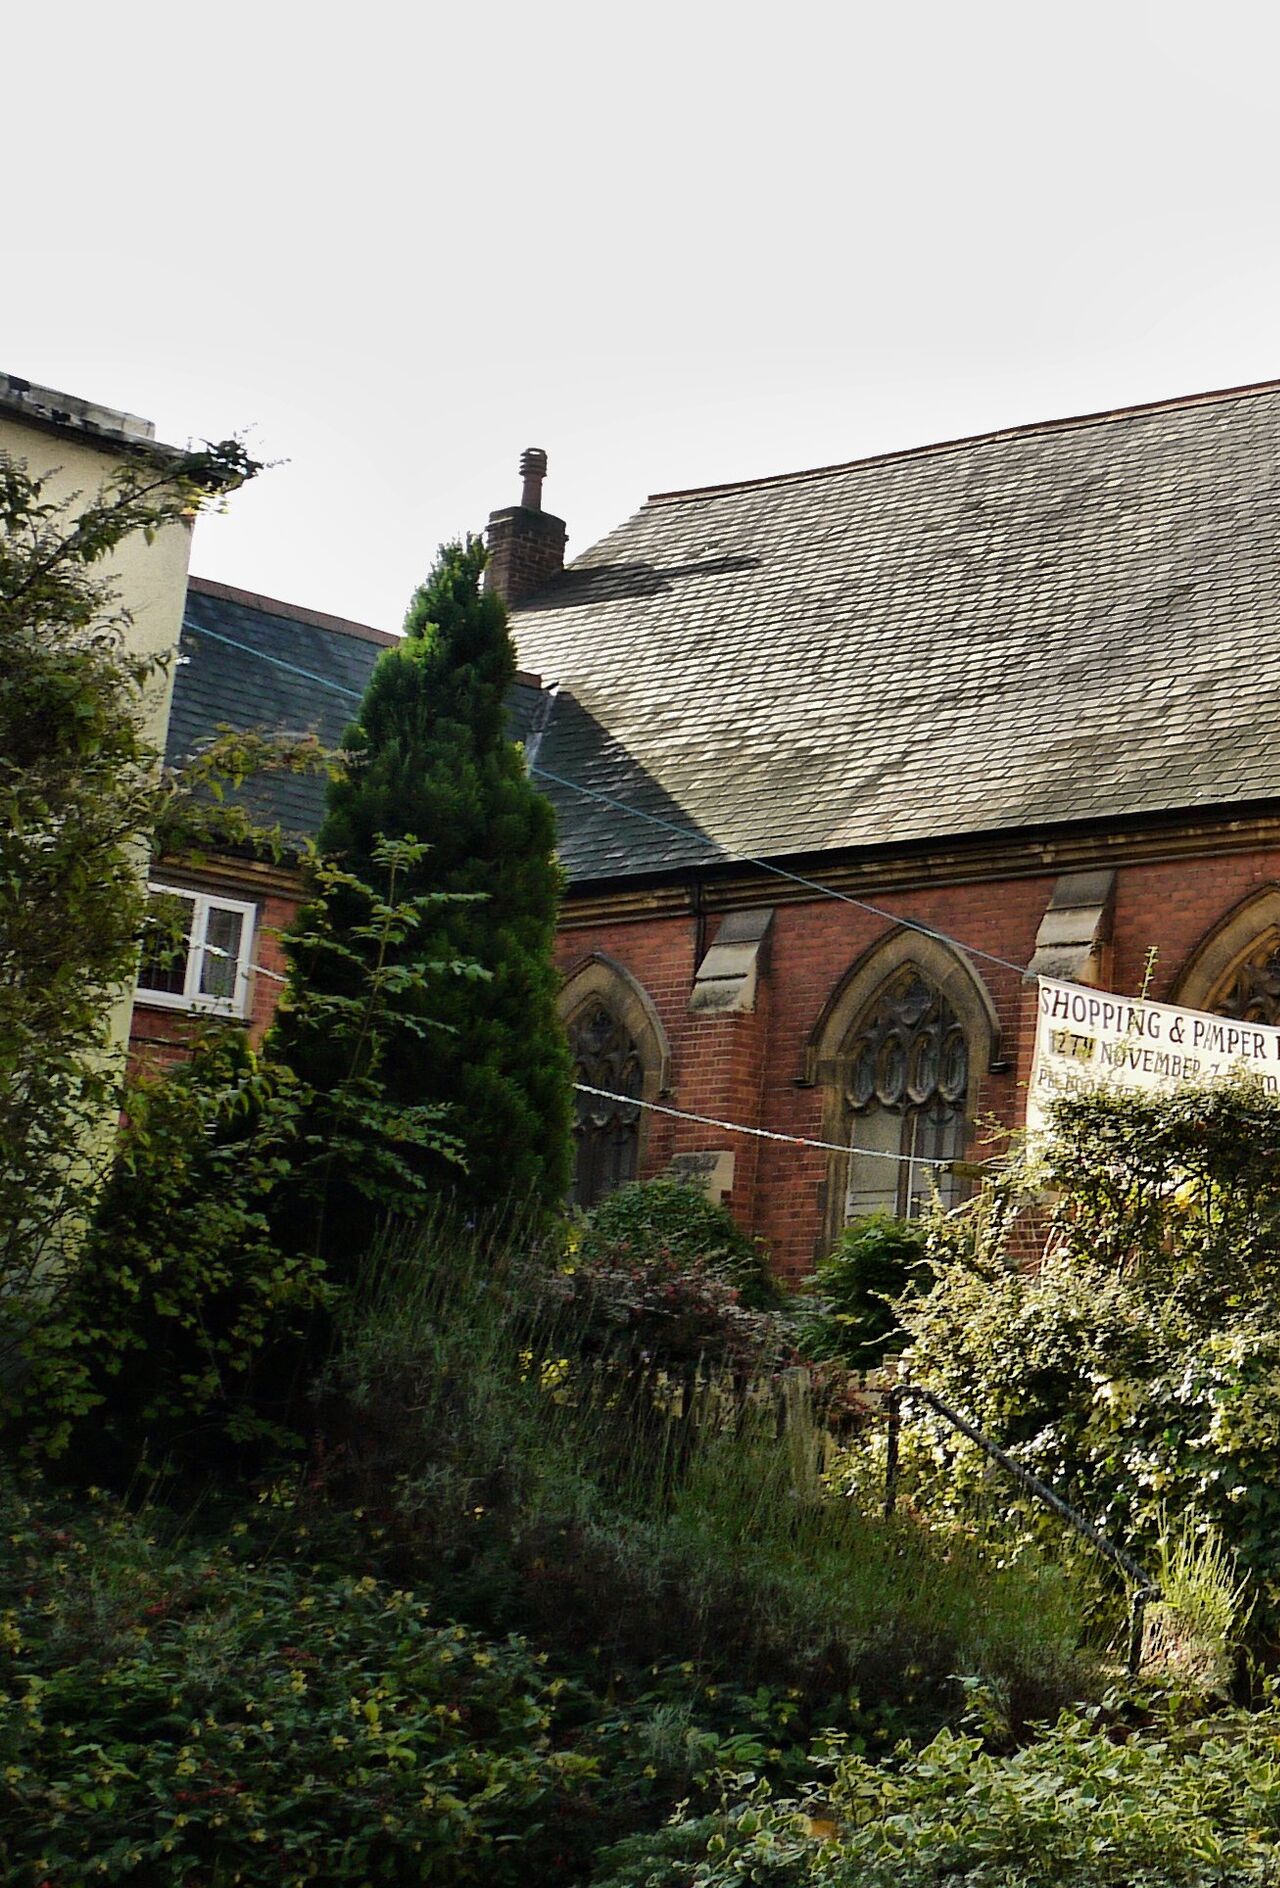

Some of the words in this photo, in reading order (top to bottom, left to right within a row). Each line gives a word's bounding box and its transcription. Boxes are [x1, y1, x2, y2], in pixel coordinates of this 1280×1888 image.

[1041, 986, 1161, 1039] SHOPPING
[1169, 1017, 1185, 1044] &
[1193, 1020, 1267, 1059] PAMPER
[1101, 1041, 1201, 1080] NOVEMBER
